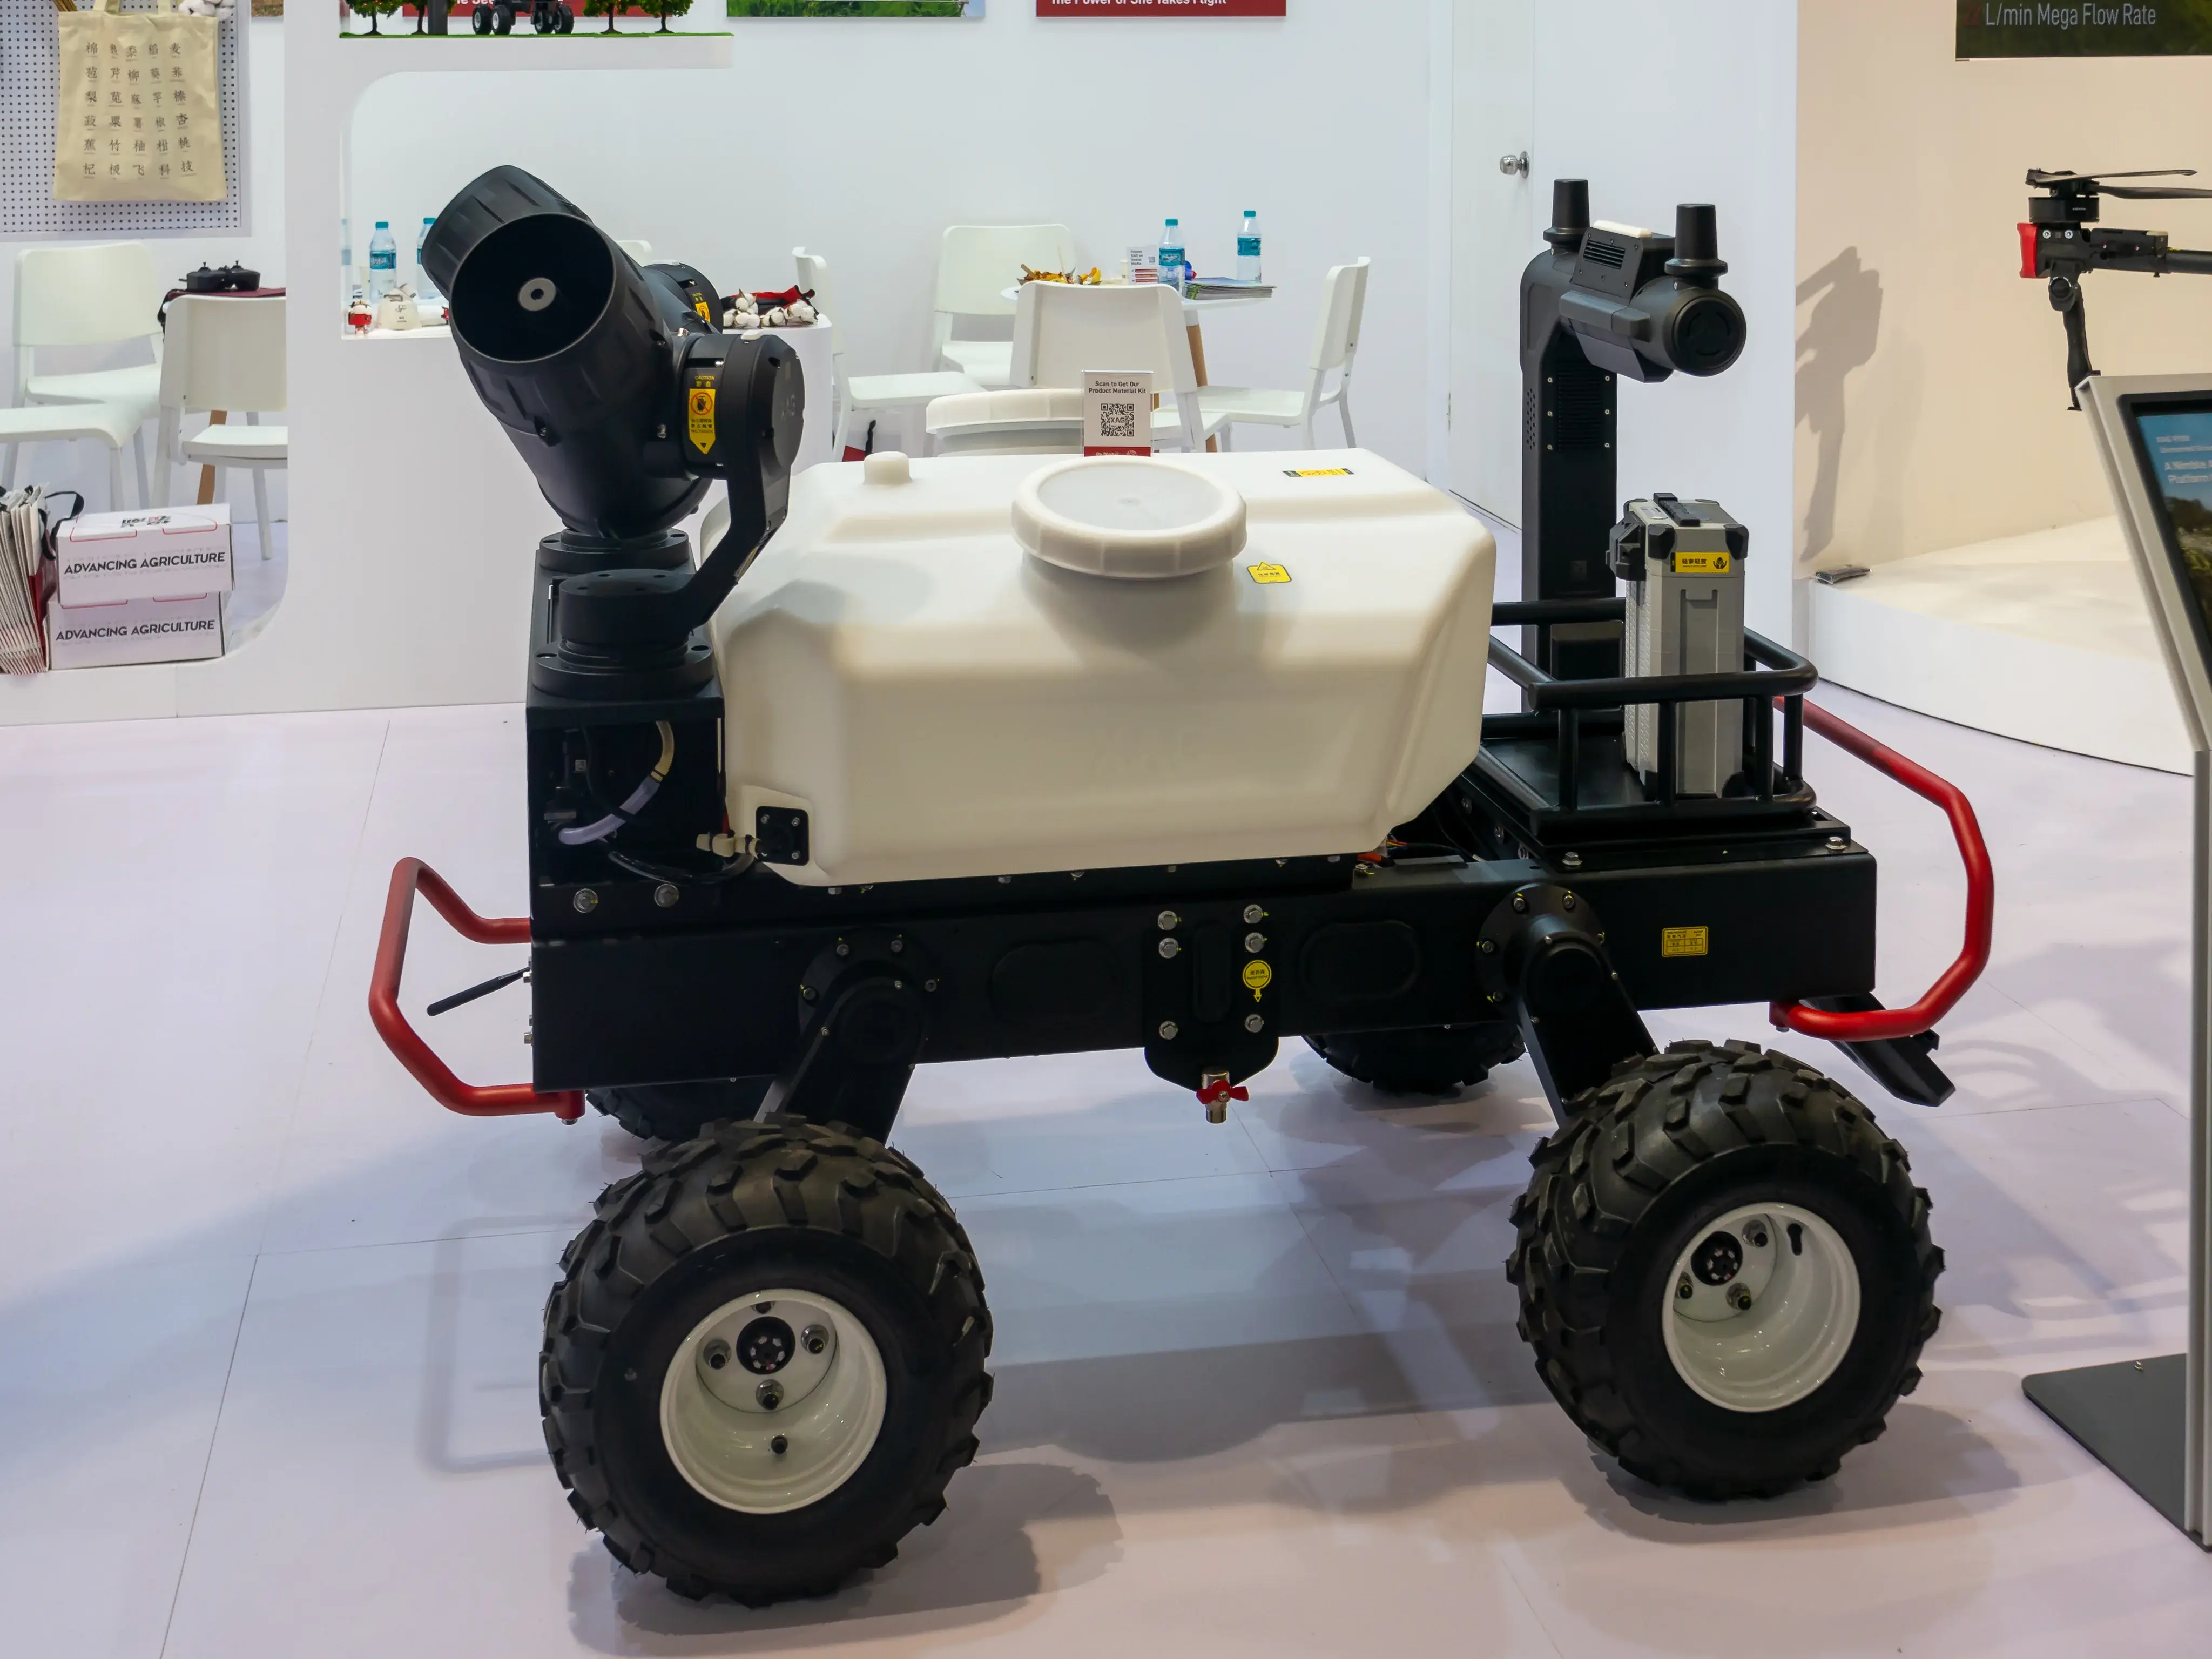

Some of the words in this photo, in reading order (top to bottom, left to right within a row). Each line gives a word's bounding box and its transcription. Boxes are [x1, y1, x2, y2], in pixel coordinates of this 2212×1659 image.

[1986, 3, 2032, 26] L/min
[2038, 3, 2078, 30] Mega
[2083, 3, 2119, 26] Flow
[2123, 3, 2156, 25] Rate
[64, 559, 137, 575] ADVANCING
[140, 552, 225, 568] AGRICULTURE
[56, 626, 127, 641] ADVANCING
[131, 619, 215, 635] AGRICULTURE
